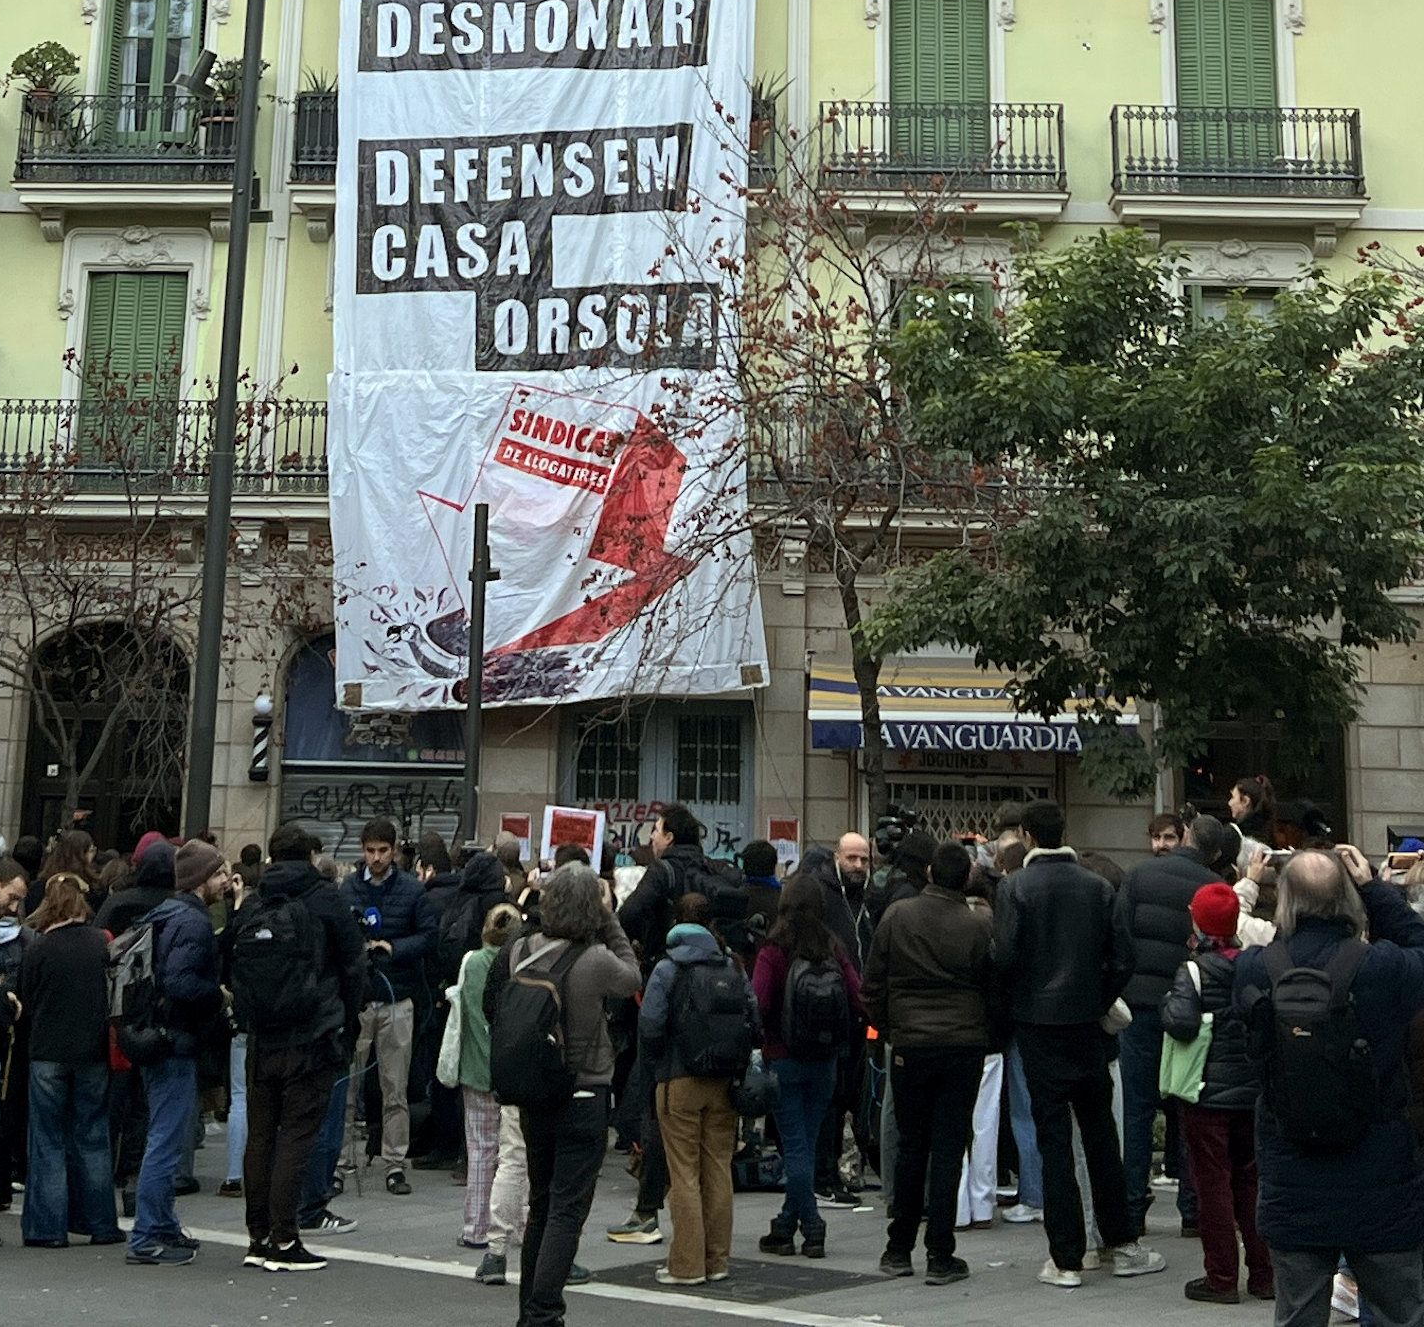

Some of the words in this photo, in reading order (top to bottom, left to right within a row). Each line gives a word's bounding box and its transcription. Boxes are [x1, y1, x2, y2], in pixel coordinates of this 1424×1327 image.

[375, 135, 680, 206] DEFENSEM
[372, 219, 532, 282] CASA
[494, 293, 718, 358] ORSOLA
[502, 445, 521, 463] DE
[525, 452, 607, 489] LLOGATERES
[896, 724, 1083, 751] VANGUARDIA
[919, 751, 988, 769] JOGUINES
